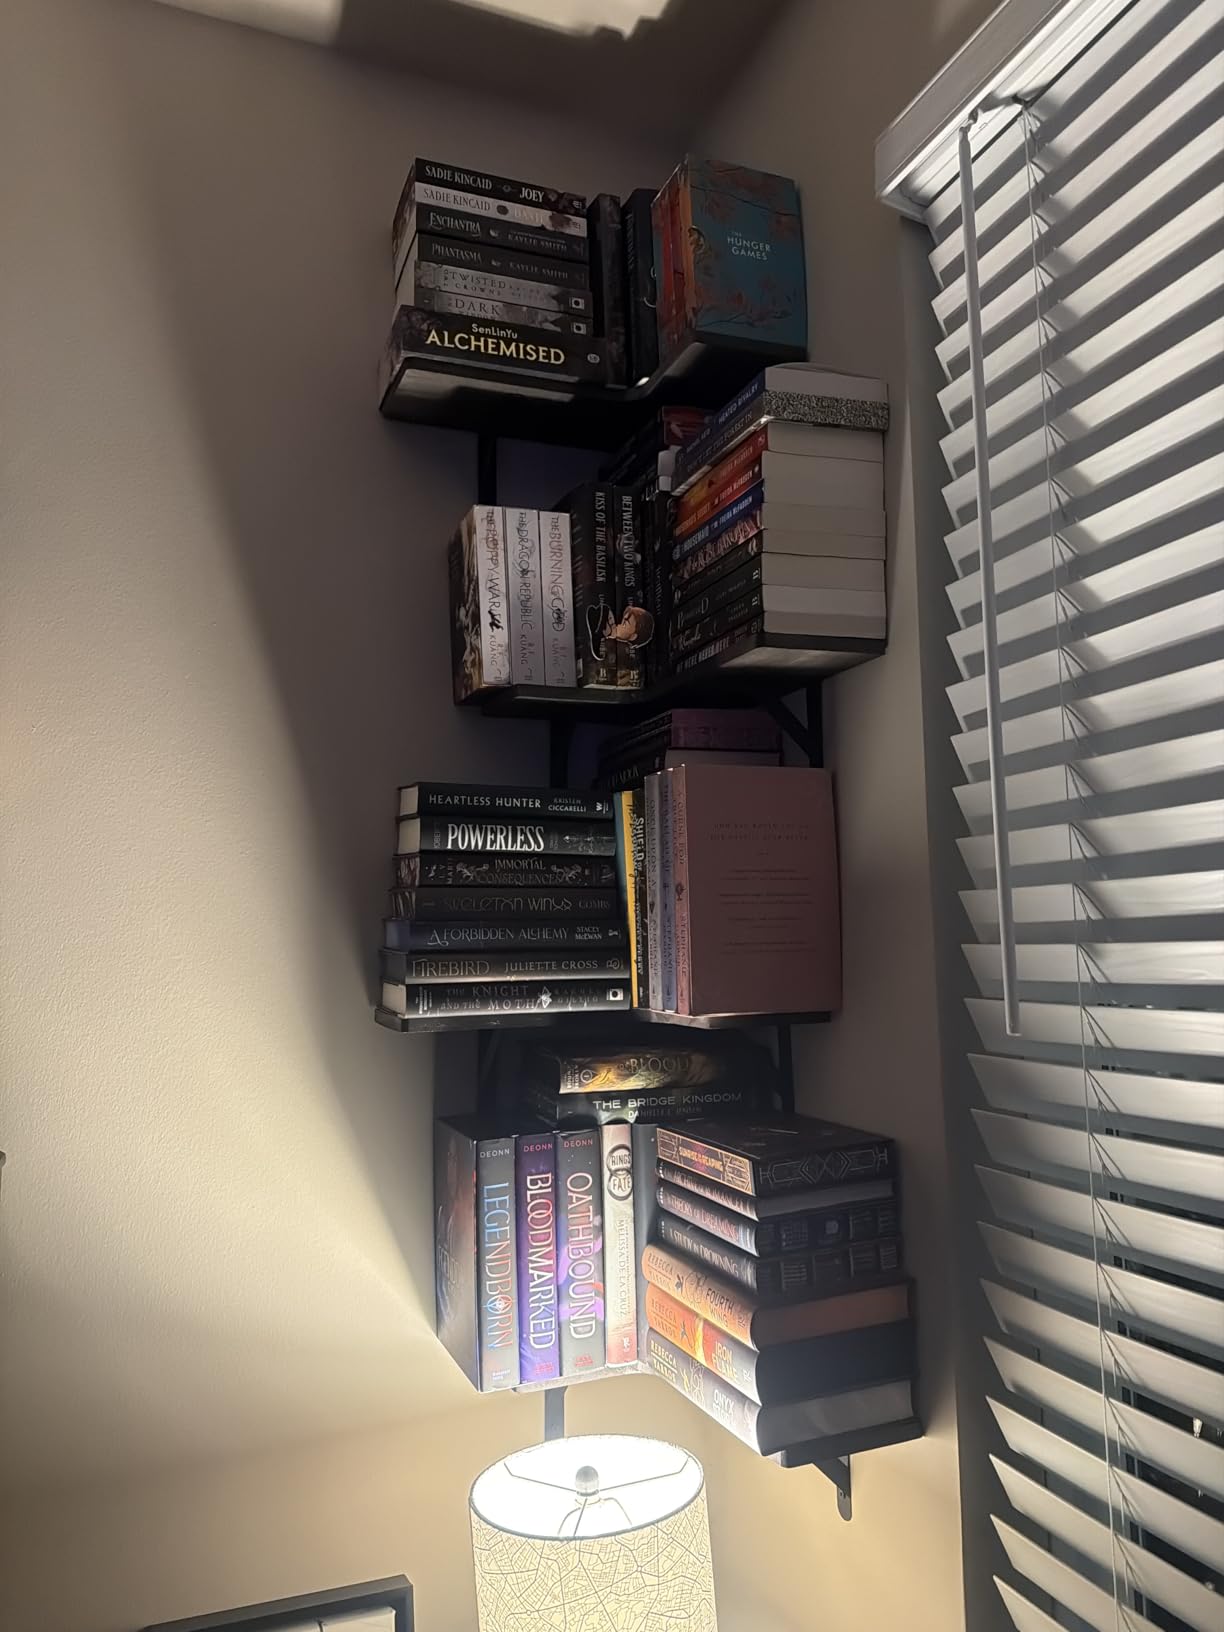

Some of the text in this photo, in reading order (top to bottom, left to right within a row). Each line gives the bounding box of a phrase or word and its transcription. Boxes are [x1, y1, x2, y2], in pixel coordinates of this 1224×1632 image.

[425, 165, 545, 203] SADIE KINCAID JOEY
[423, 188, 451, 204] SADIE
[453, 194, 491, 212] KINCAID
[429, 211, 482, 237] ENCHANTRA
[431, 243, 483, 265] PHANTASMA
[540, 239, 568, 251] SMITH
[727, 235, 772, 253] HUNGER
[731, 247, 769, 261] GAMES
[450, 271, 507, 290] TWISTED
[455, 298, 501, 316] DARK
[472, 323, 519, 340] SenLinYu
[425, 329, 566, 366] ALCHEMISED
[595, 491, 605, 510] KISS
[595, 511, 605, 525] OF
[621, 495, 633, 537] BETWEEN
[595, 527, 606, 543] THE
[517, 528, 530, 580] DRAGON
[622, 539, 634, 560] TWO
[549, 532, 565, 596] BURNING
[595, 544, 606, 583] BASILISK
[623, 561, 635, 587] KINGS
[488, 577, 501, 609] WAR
[520, 582, 533, 631] REPUBLIC
[519, 634, 528, 665] KUANG
[428, 793, 541, 809] HEARTLESS HUNTER
[547, 804, 587, 813] CICCARELLI
[446, 823, 545, 852] POWERLESS
[635, 816, 645, 861] SHIELD
[495, 858, 547, 871] IMMORTAL
[476, 871, 565, 888] CONSEQUENCES
[427, 927, 570, 947] A FORBIDDEN ALCHEMY
[576, 925, 601, 933] STACEY
[412, 958, 599, 978] FIREBIRD JULIETTE CROSS
[472, 985, 529, 997] KNIGHT
[488, 998, 537, 1011] MOTH
[592, 1092, 743, 1110] THE BRIDGE KINGDOM
[479, 1148, 511, 1159] DEONN
[523, 1143, 553, 1153] DEONN
[563, 1138, 594, 1149] DEONN
[611, 1152, 632, 1166] RINGS
[611, 1177, 632, 1191] FATE
[701, 1208, 739, 1241] DREAMING
[617, 1218, 625, 1258] MELISSA
[526, 1172, 556, 1350] BLOODMARKED
[566, 1172, 596, 1340] OATHBOUND
[647, 1252, 674, 1276] REBECCA
[674, 1230, 693, 1251] STUDY
[700, 1244, 739, 1277] DROWNING
[483, 1182, 514, 1351] LEGENDBORN
[651, 1299, 677, 1323] REBECCA
[705, 1288, 735, 1315] FOURTH
[650, 1340, 677, 1369] REBECCA
[715, 1341, 733, 1364] IRON
[713, 1389, 735, 1415] ONYX
